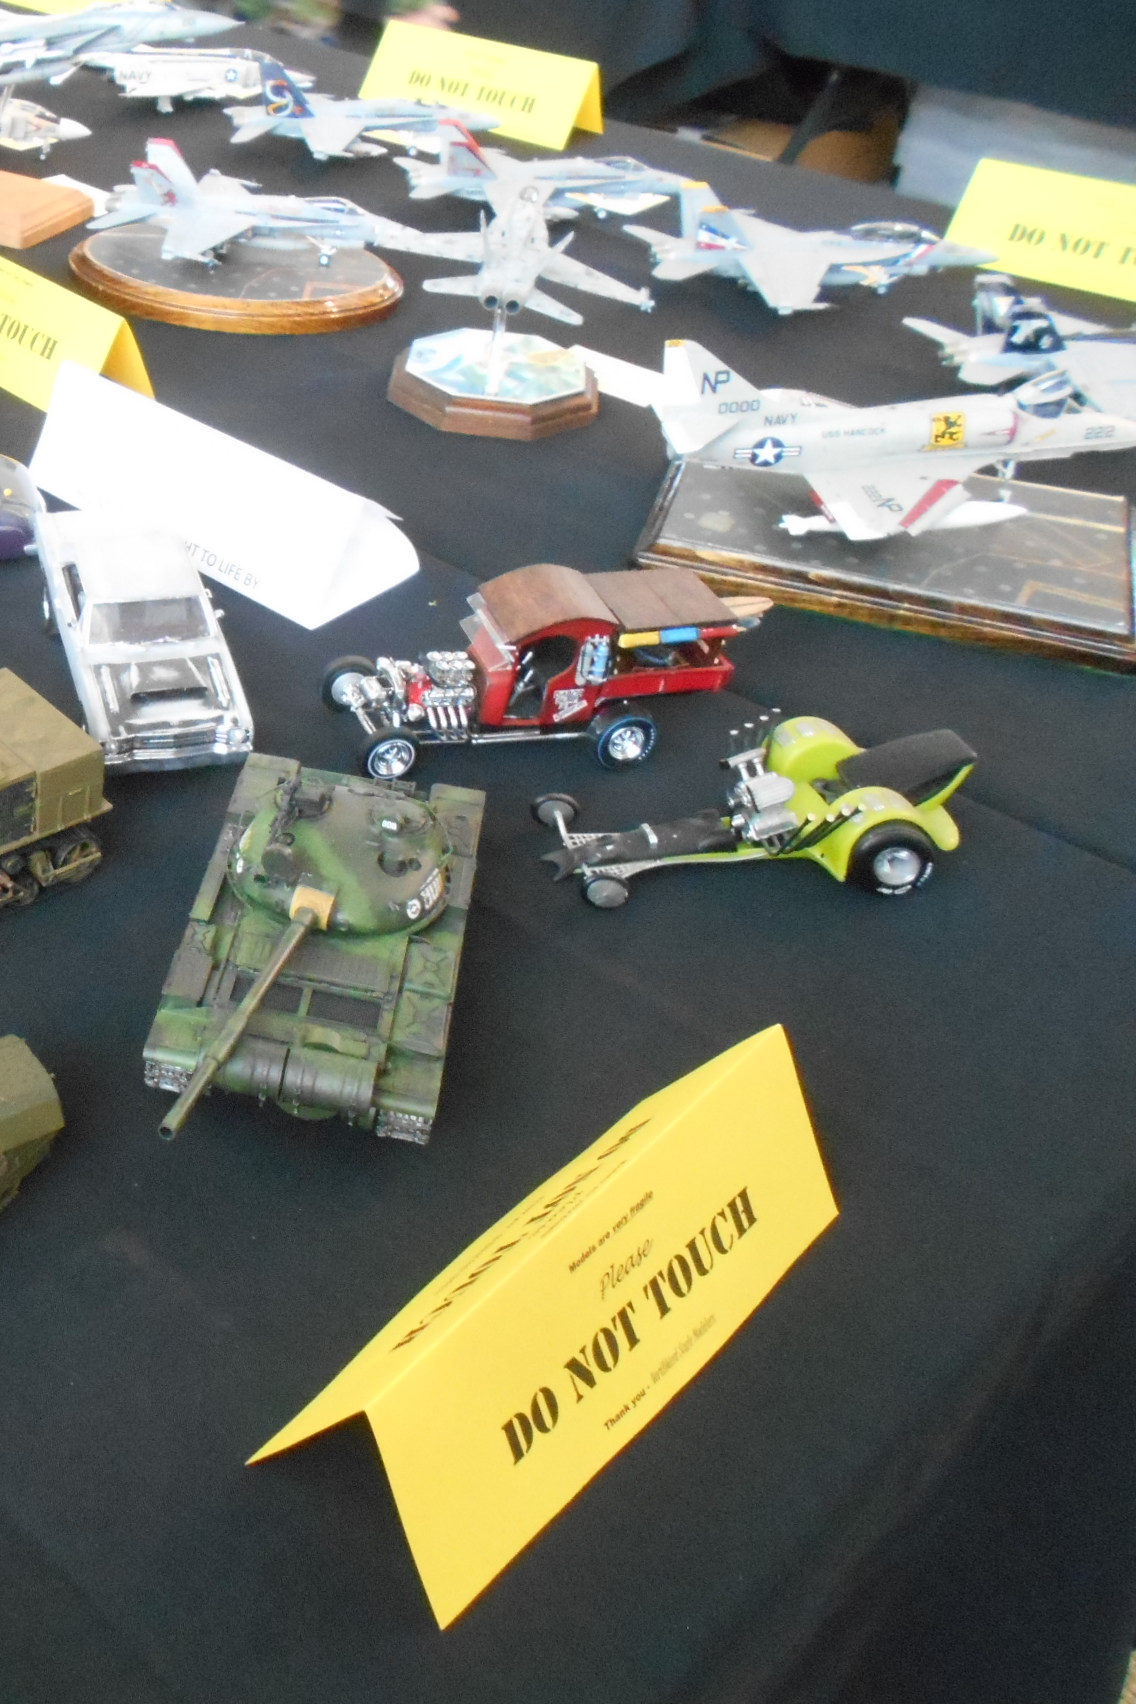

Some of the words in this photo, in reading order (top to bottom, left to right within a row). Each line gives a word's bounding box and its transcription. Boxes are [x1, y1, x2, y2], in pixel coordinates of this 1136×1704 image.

[118, 69, 152, 81] NAVY
[408, 70, 432, 87] DO
[437, 76, 469, 97] NOT
[476, 86, 536, 114] TOUCH
[1008, 223, 1046, 246] DO
[1051, 232, 1110, 260] NOT
[701, 370, 731, 395] NP
[763, 412, 799, 427] NAVY
[1083, 424, 1116, 440] 222
[201, 548, 218, 567] TO
[218, 560, 243, 582] LIFE
[243, 572, 261, 589] BY
[599, 1237, 654, 1301] Please
[501, 1386, 559, 1466] DO
[564, 1301, 640, 1405] NOT
[642, 1186, 758, 1320] TOUCH
[604, 1403, 631, 1431] Thank
[630, 1387, 647, 1409] you
